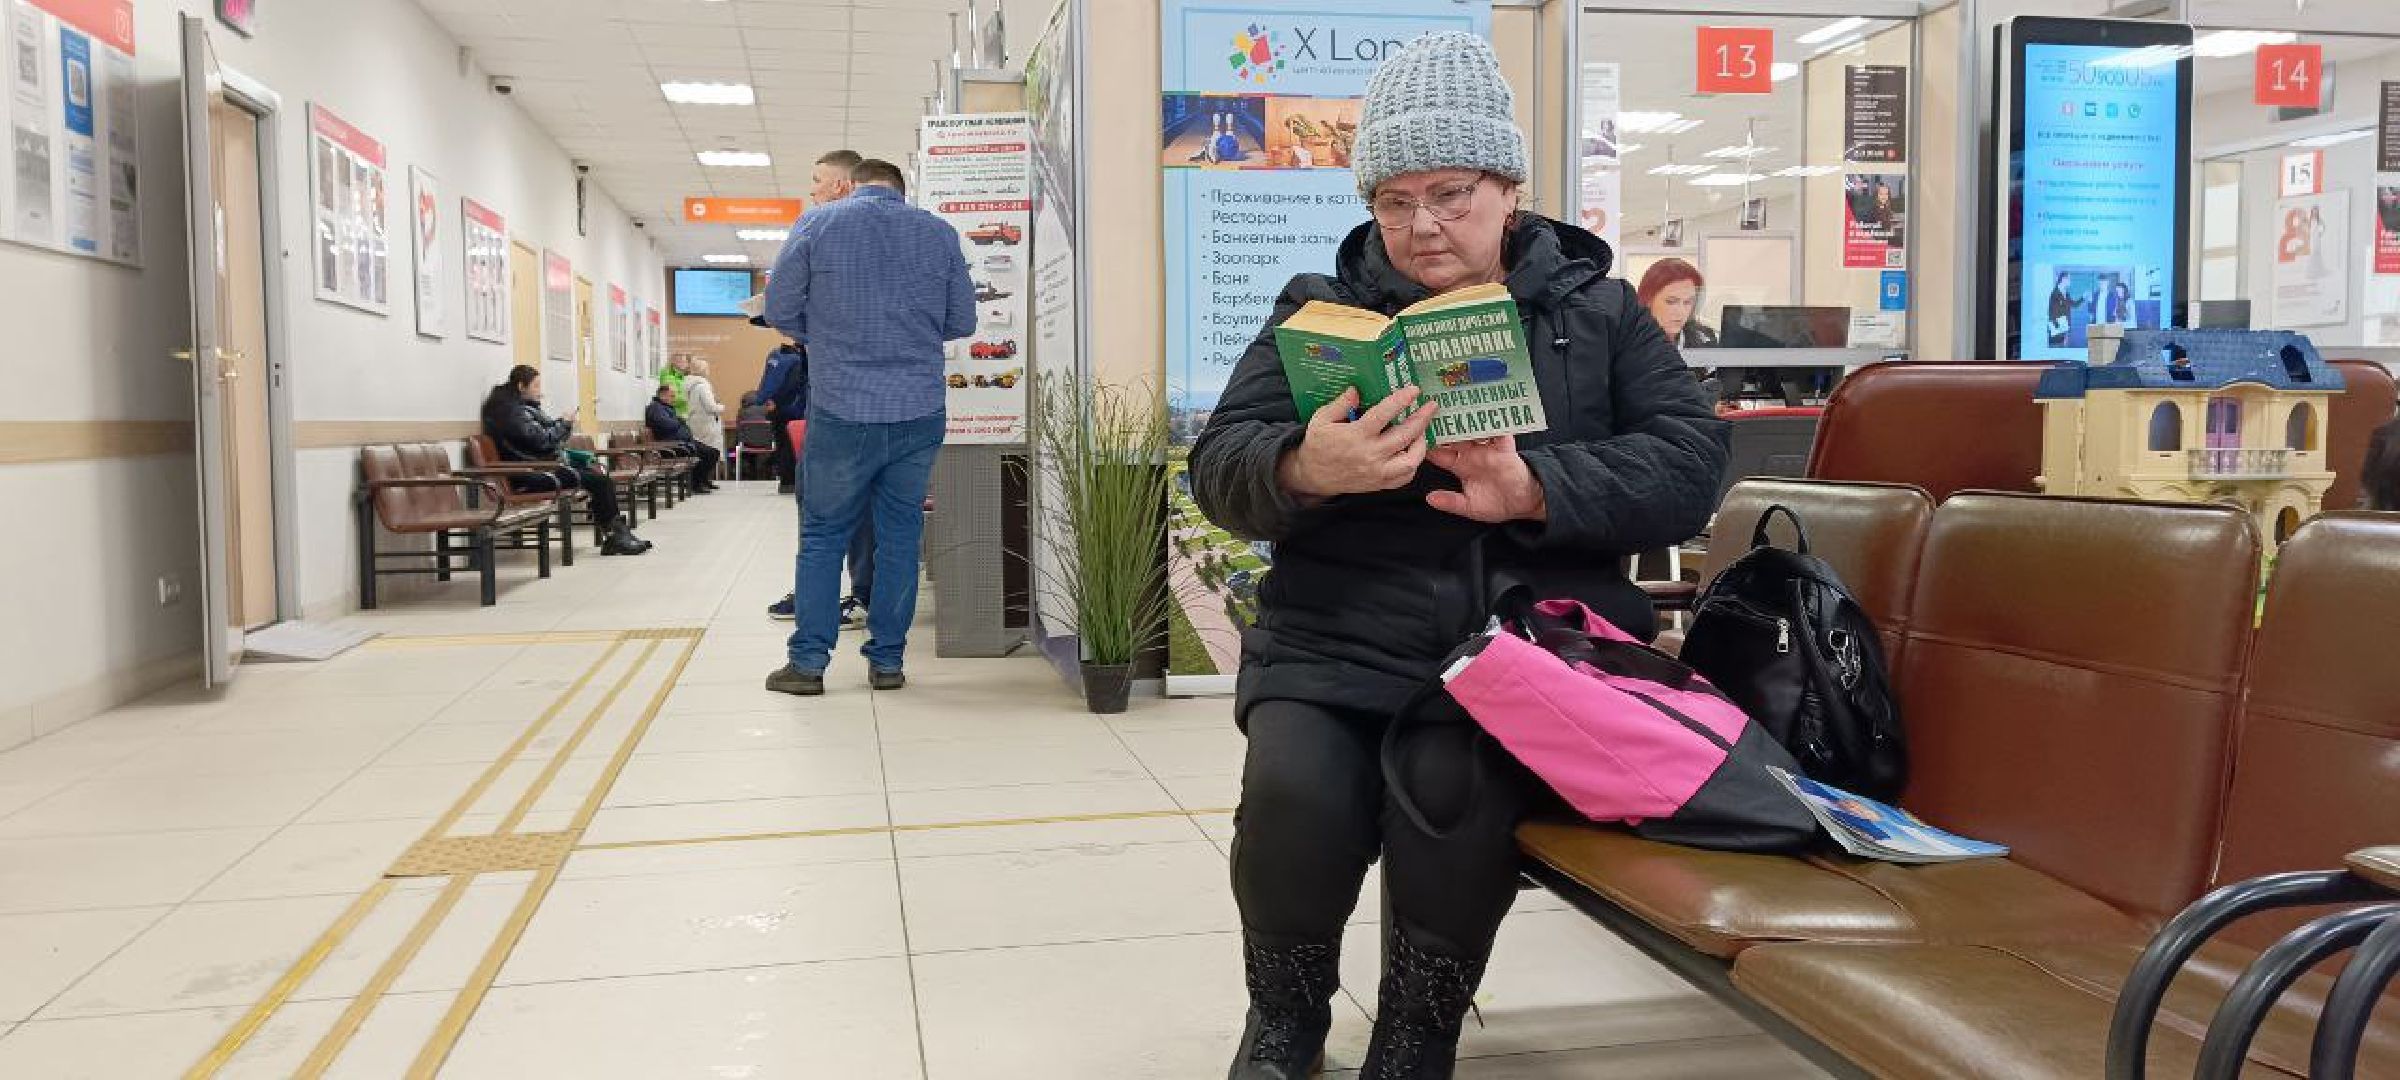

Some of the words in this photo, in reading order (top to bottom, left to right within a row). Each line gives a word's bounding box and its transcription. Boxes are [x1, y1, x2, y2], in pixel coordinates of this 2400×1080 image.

[1294, 27, 1317, 60] X
[1330, 28, 1410, 61] Lan
[1715, 44, 1758, 78] 13
[2270, 59, 2309, 92] 14
[2290, 162, 2311, 184] 15
[1211, 188, 1311, 206] Проживание
[1315, 194, 1324, 204] в
[1328, 194, 1359, 205] котт
[1212, 209, 1287, 226] Ресторан
[1212, 229, 1296, 244] Банкетные
[1212, 250, 1281, 267] Зоопарк
[1212, 270, 1249, 285] Баня
[1212, 312, 1269, 328] Боулин
[1212, 331, 1253, 345] Пейн
[1410, 330, 1516, 362] СПРАВОЧНИК
[1212, 351, 1243, 365] Ры
[1432, 405, 1536, 437] ЛЕКАРСТВА
